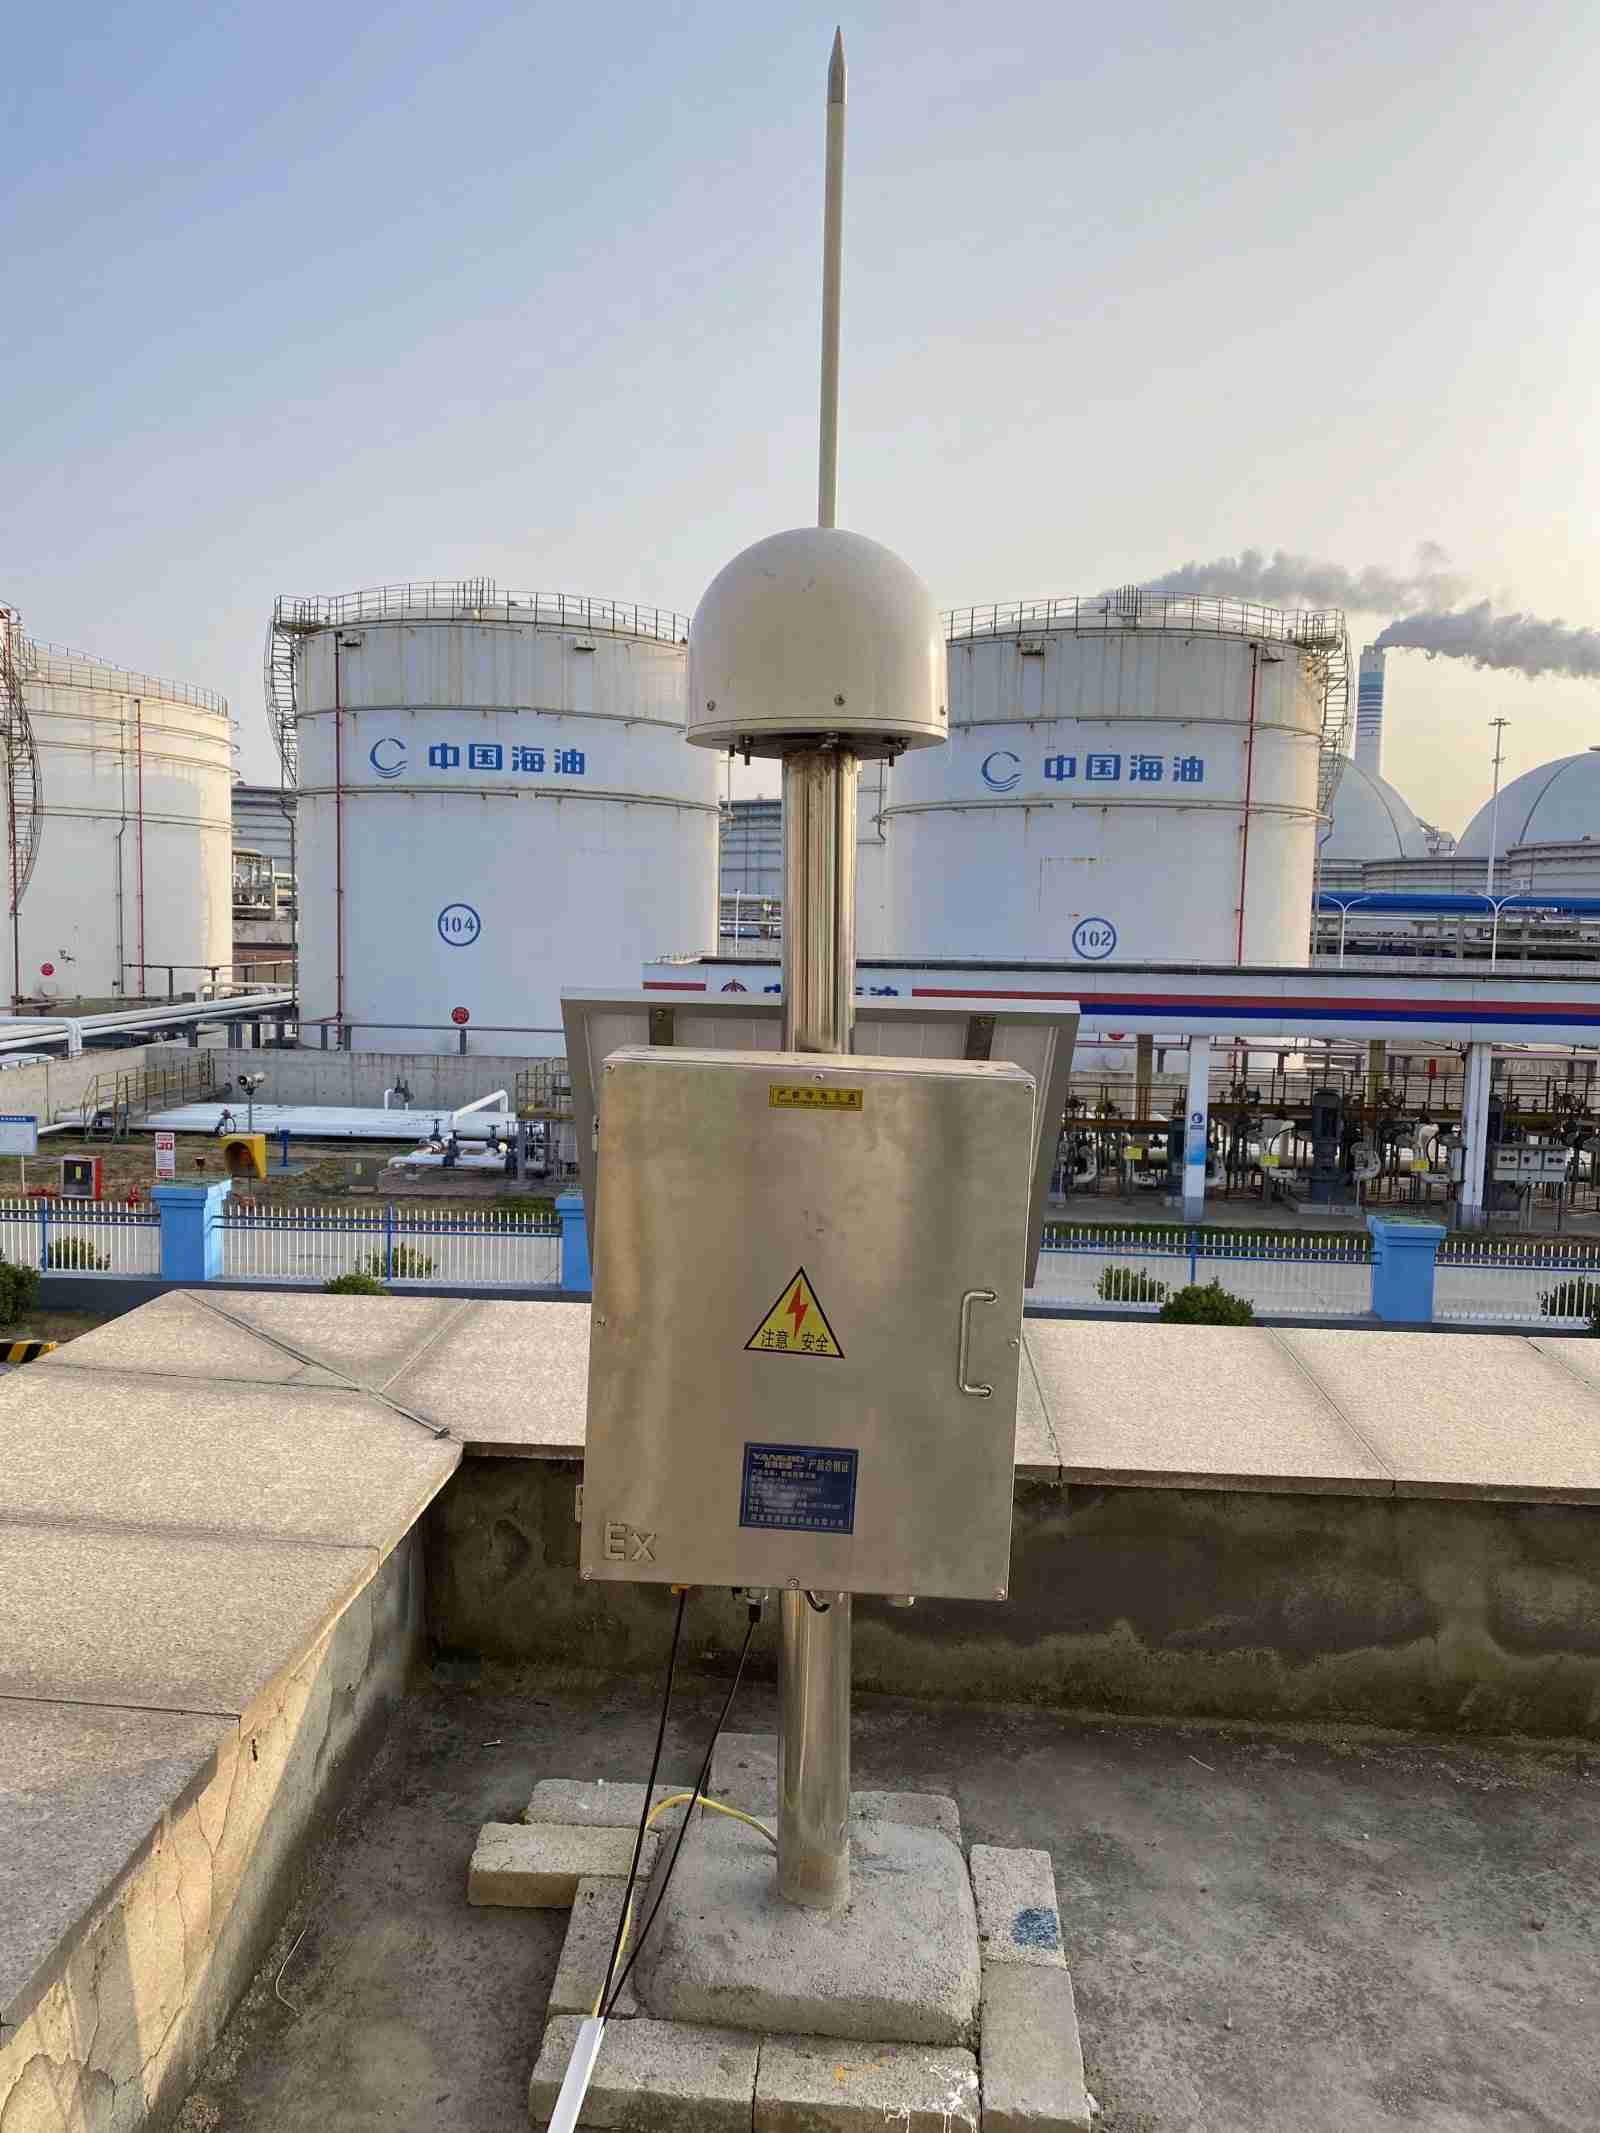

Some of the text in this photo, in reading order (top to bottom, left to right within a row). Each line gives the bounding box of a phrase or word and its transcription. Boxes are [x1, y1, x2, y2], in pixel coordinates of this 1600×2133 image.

[429, 743, 585, 775] 中国海油
[1044, 754, 1204, 782] 中国海油
[441, 917, 475, 932] 104
[1079, 930, 1111, 946] 102
[761, 1328, 828, 1352] 注意 安全
